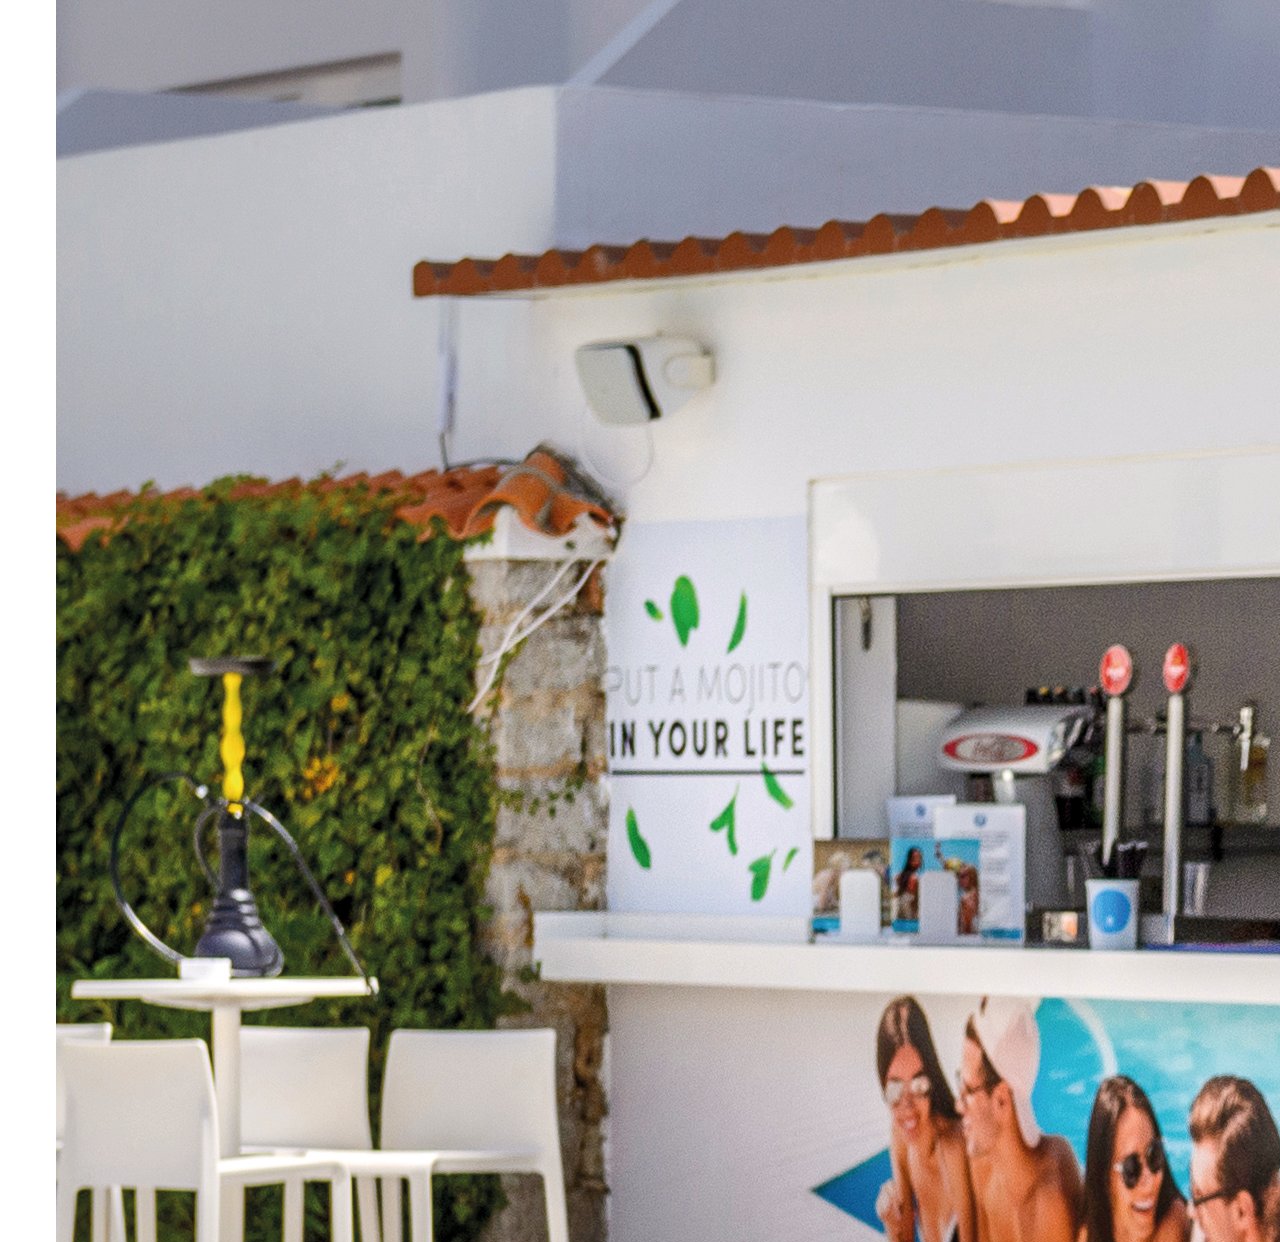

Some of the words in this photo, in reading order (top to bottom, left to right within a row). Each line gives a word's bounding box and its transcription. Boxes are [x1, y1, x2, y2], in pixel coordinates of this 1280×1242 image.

[606, 663, 657, 706] PUT
[670, 666, 687, 703] A
[698, 660, 808, 716] MOJITO
[610, 719, 636, 757] IN
[648, 718, 730, 758] YOUR
[744, 717, 805, 757] LIFE
